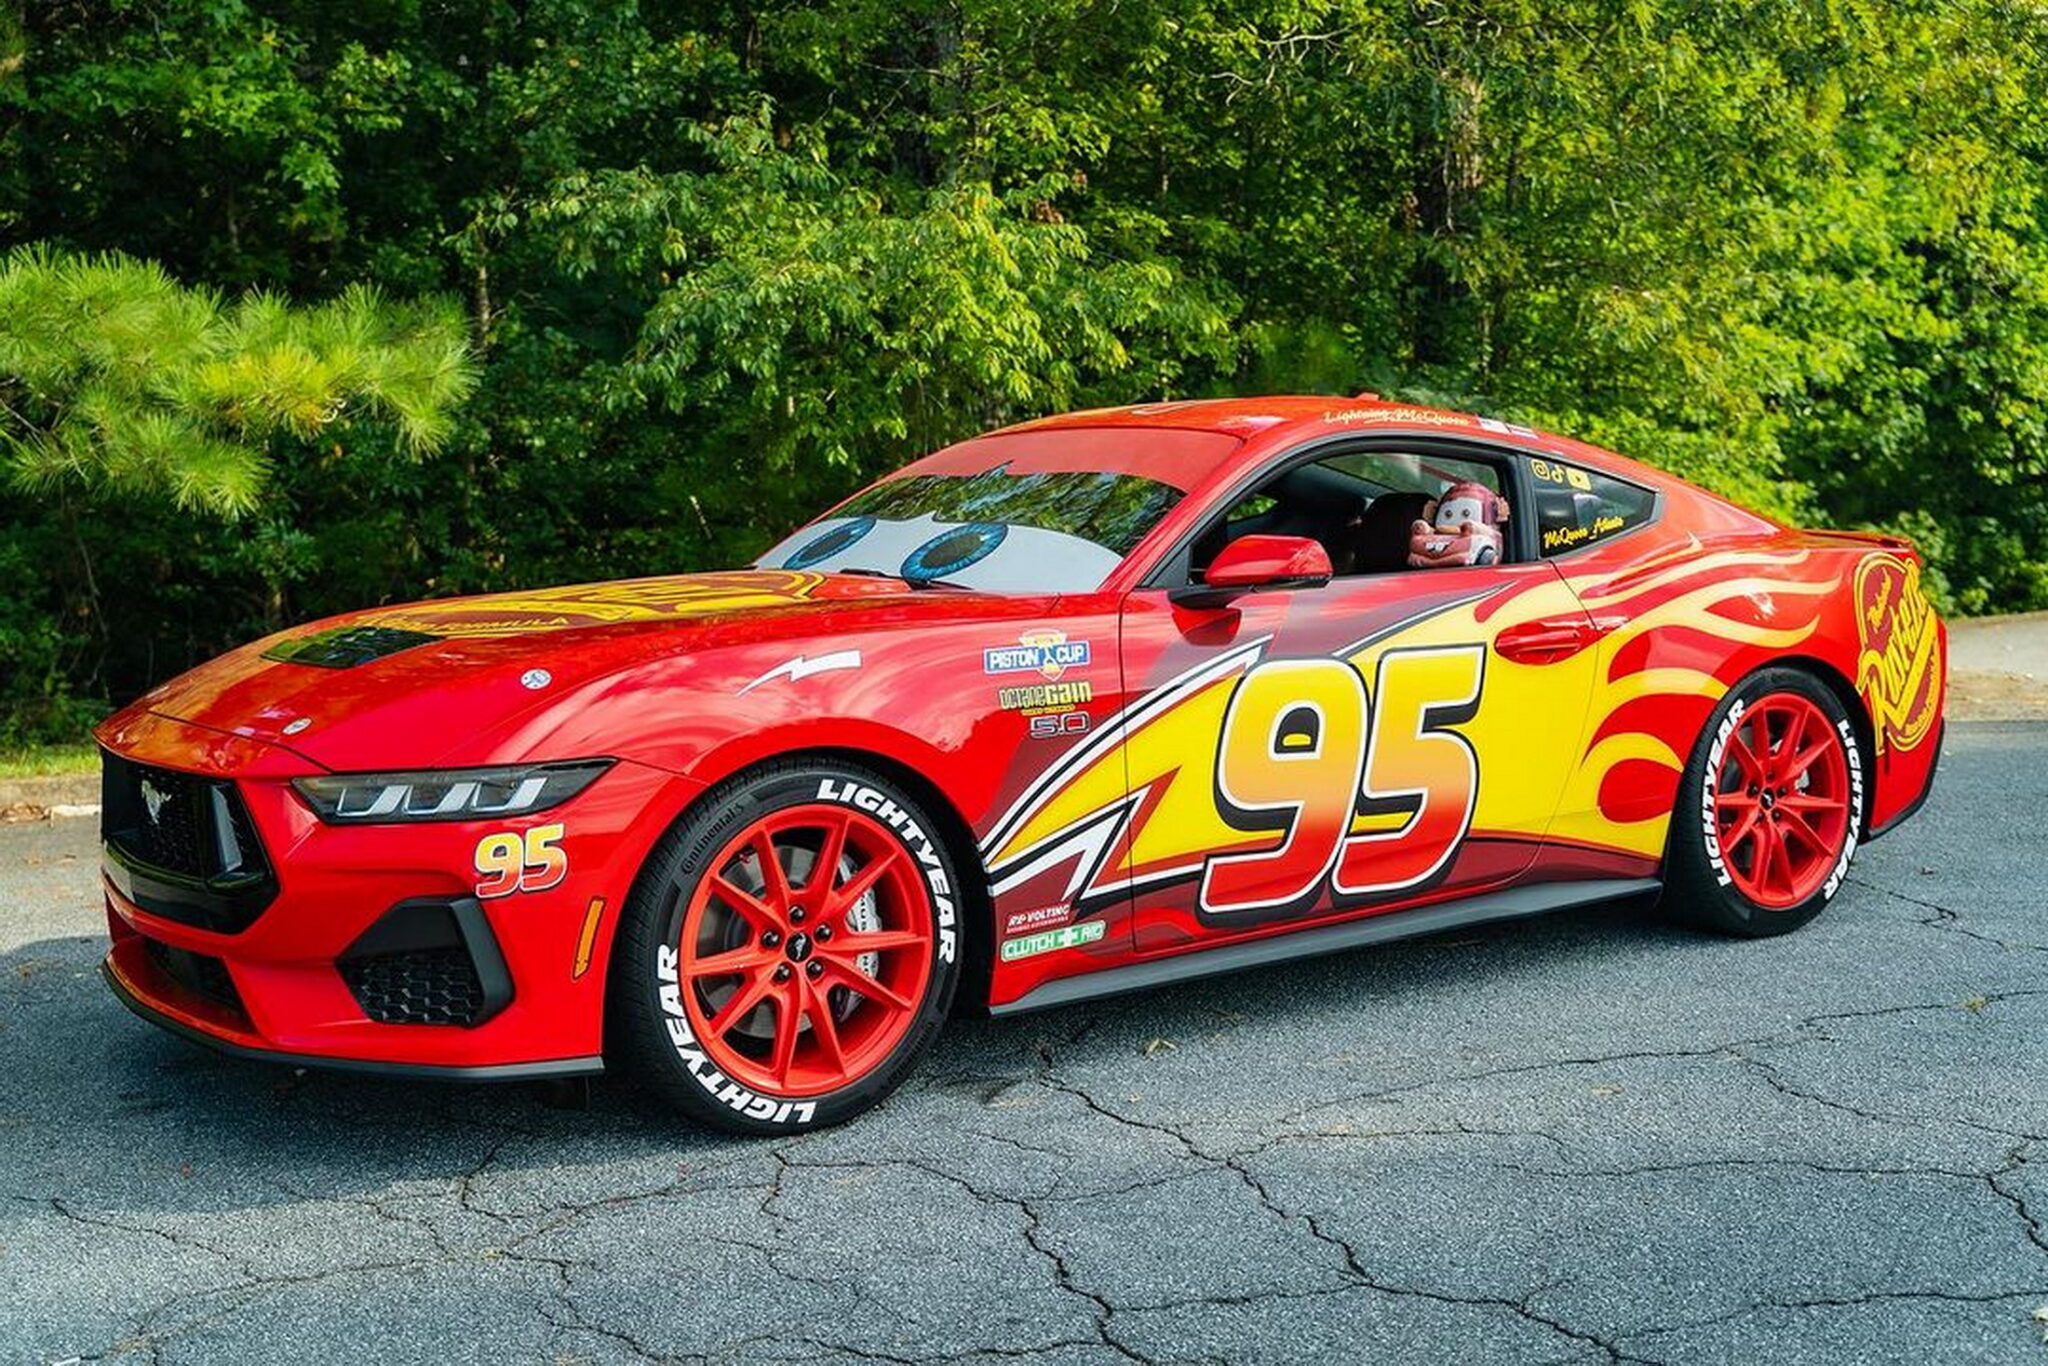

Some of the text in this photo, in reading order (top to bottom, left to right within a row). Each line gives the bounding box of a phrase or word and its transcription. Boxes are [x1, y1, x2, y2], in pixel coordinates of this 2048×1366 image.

[988, 645, 1085, 669] PISTON CUP
[1030, 711, 1091, 739] 5.0
[474, 823, 568, 899] 95
[1197, 643, 1487, 918] 95
[1702, 699, 1747, 887] LIGHTYEAR
[1823, 719, 1863, 900] LIGHTYEAR
[816, 779, 956, 965] LIGHTYEAR
[1004, 931, 1055, 958] CLUTCH
[658, 945, 817, 1123] LIGHTYEAR
